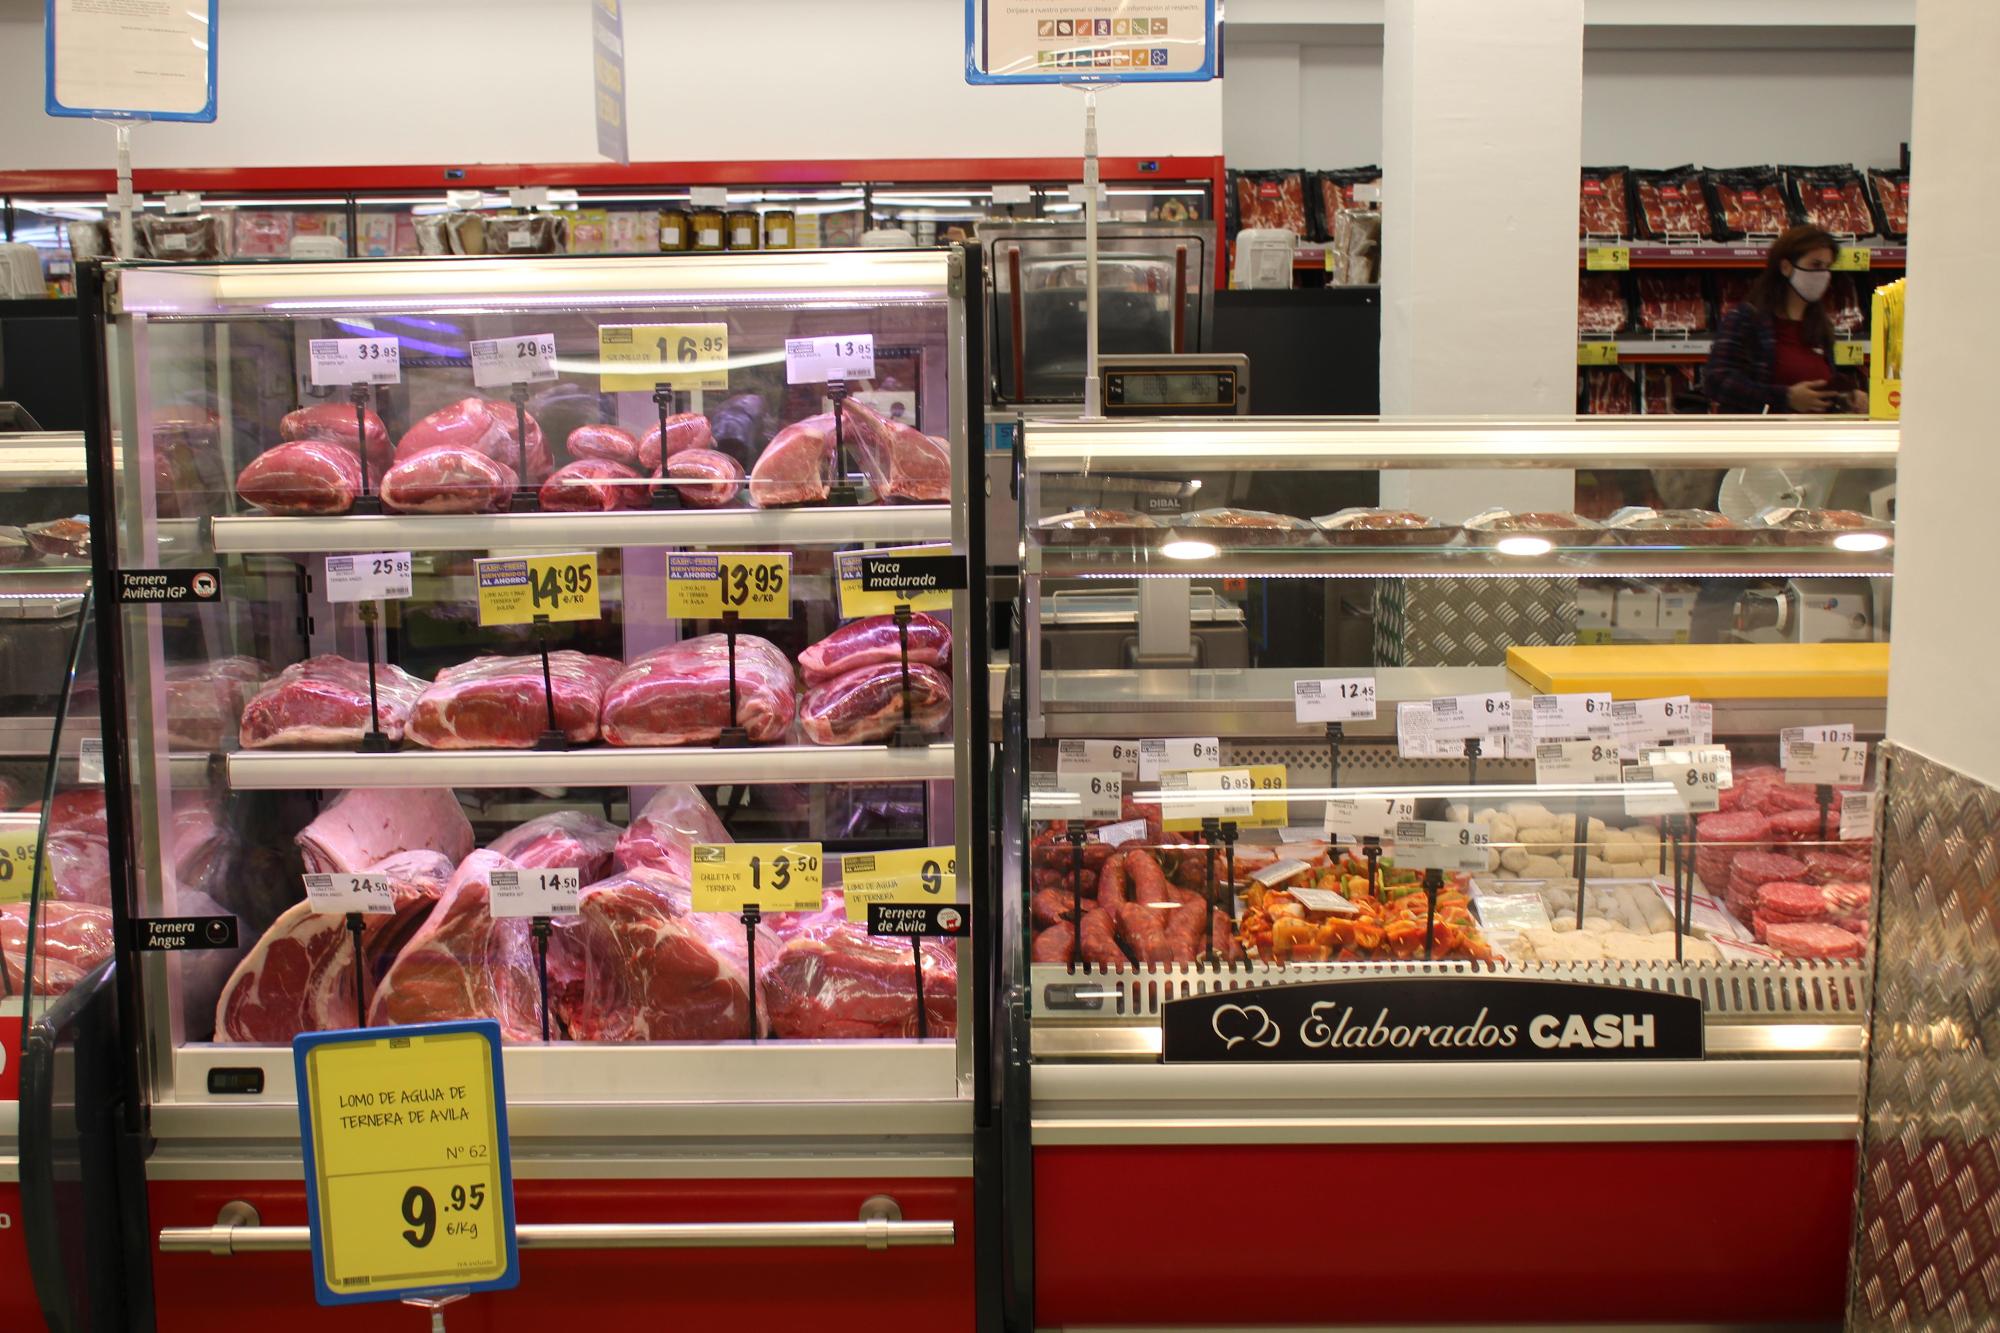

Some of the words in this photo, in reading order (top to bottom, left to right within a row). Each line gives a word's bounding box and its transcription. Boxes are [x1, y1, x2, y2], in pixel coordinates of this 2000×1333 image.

[358, 343, 398, 360] 33.95
[516, 340, 555, 358] 29.95
[834, 341, 872, 357] 13.95
[1149, 499, 1181, 508] DIBAL
[371, 558, 410, 576] 25.95
[870, 560, 900, 574] Vaca
[123, 573, 167, 585] Ternera
[494, 576, 527, 585] AHORRO
[671, 571, 682, 579] AL
[683, 571, 717, 579] AHORRO
[869, 574, 937, 588] madurada
[122, 586, 165, 599] Avileña
[166, 587, 187, 598] IGP
[1340, 683, 1374, 698] 12.45
[1485, 698, 1511, 713] 6.45
[1586, 698, 1611, 713] 6.77
[1664, 702, 1689, 717] 6.77
[1112, 744, 1138, 760] 6.95
[1193, 742, 1218, 757] 6.95
[1091, 777, 1120, 794] 6.95
[1459, 829, 1488, 846] 9.95
[732, 873, 742, 881] DE
[749, 855, 818, 891] 13.50
[921, 859, 956, 895] 9.9
[351, 878, 389, 894] 24.50
[539, 874, 578, 891] 14.50
[877, 907, 926, 920] Ternera
[148, 921, 195, 933] Ternera
[878, 920, 895, 933] de
[896, 918, 927, 932] Ávila
[148, 935, 186, 949] Angus
[1300, 1001, 1518, 1049] Elaborados
[1528, 1013, 1655, 1050] CASH
[339, 1094, 375, 1108] LOMO
[379, 1091, 396, 1104] DE
[400, 1088, 444, 1103] AGUJA
[449, 1086, 467, 1100] DE
[340, 1113, 404, 1129] TERNERA
[408, 1111, 425, 1125] DE
[430, 1107, 469, 1122] AVILA
[446, 1145, 464, 1159] Nº
[469, 1144, 488, 1159] 62
[401, 1183, 486, 1248] 9.95
[446, 1221, 478, 1239] €/Kg
